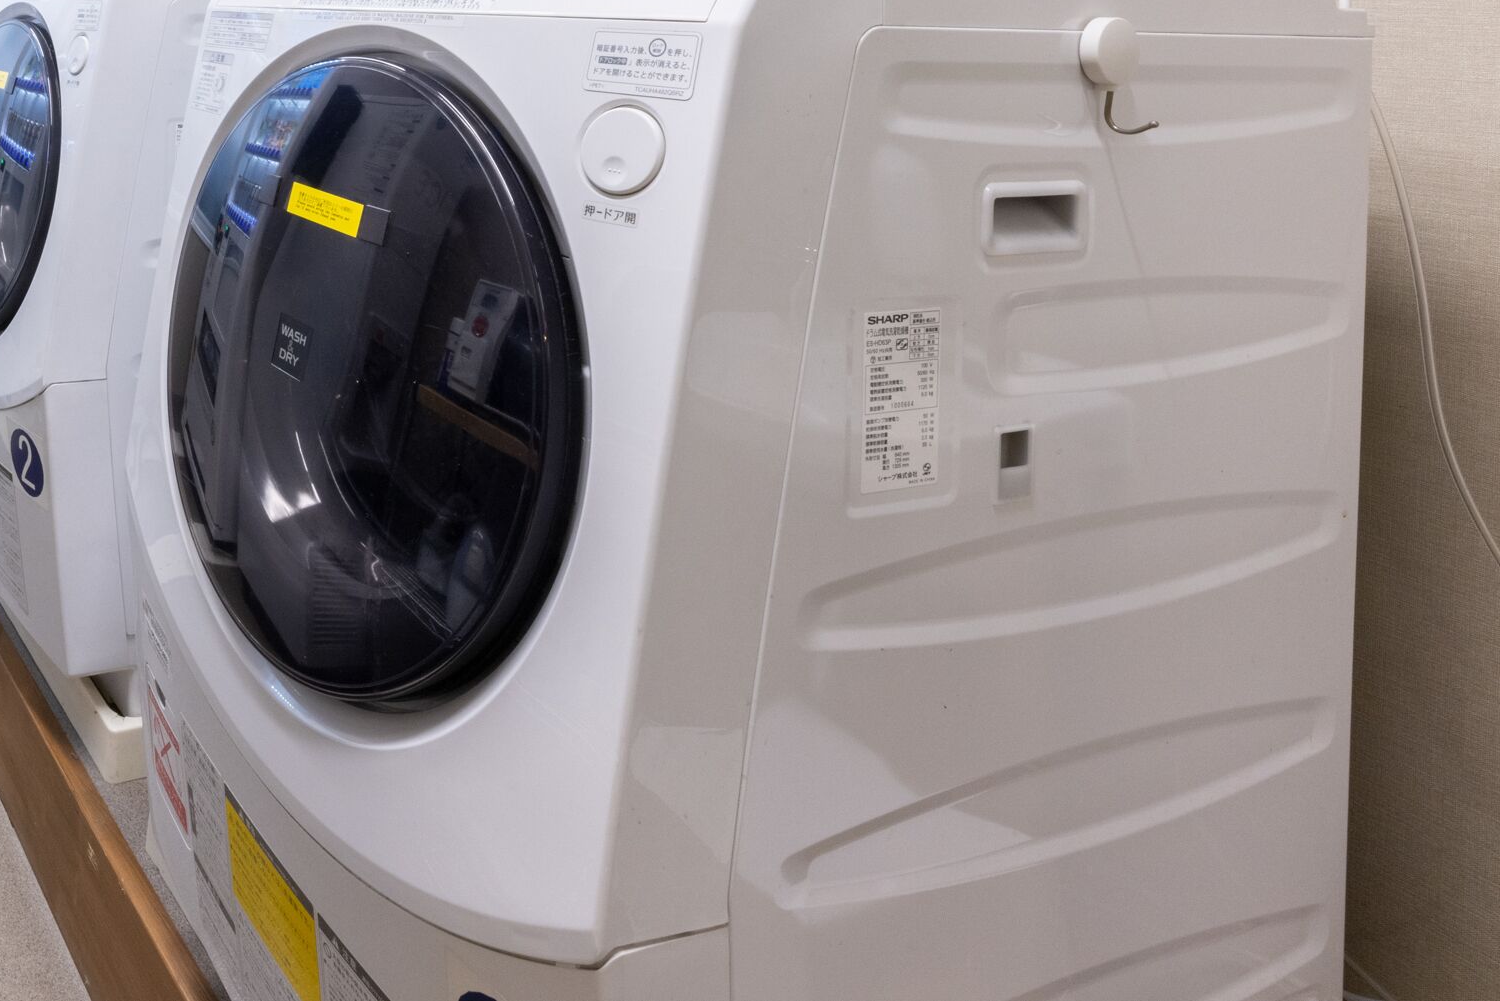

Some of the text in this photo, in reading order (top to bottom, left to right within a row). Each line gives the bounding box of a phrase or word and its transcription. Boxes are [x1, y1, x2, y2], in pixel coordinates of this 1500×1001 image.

[593, 68, 688, 82] ドアを開けることができます。
[867, 313, 909, 325] SHARP
[281, 323, 307, 347] WASH
[288, 340, 294, 353] &
[279, 347, 299, 367] DRY
[18, 434, 36, 490] 2
[878, 471, 918, 483] シャープ株式会社
